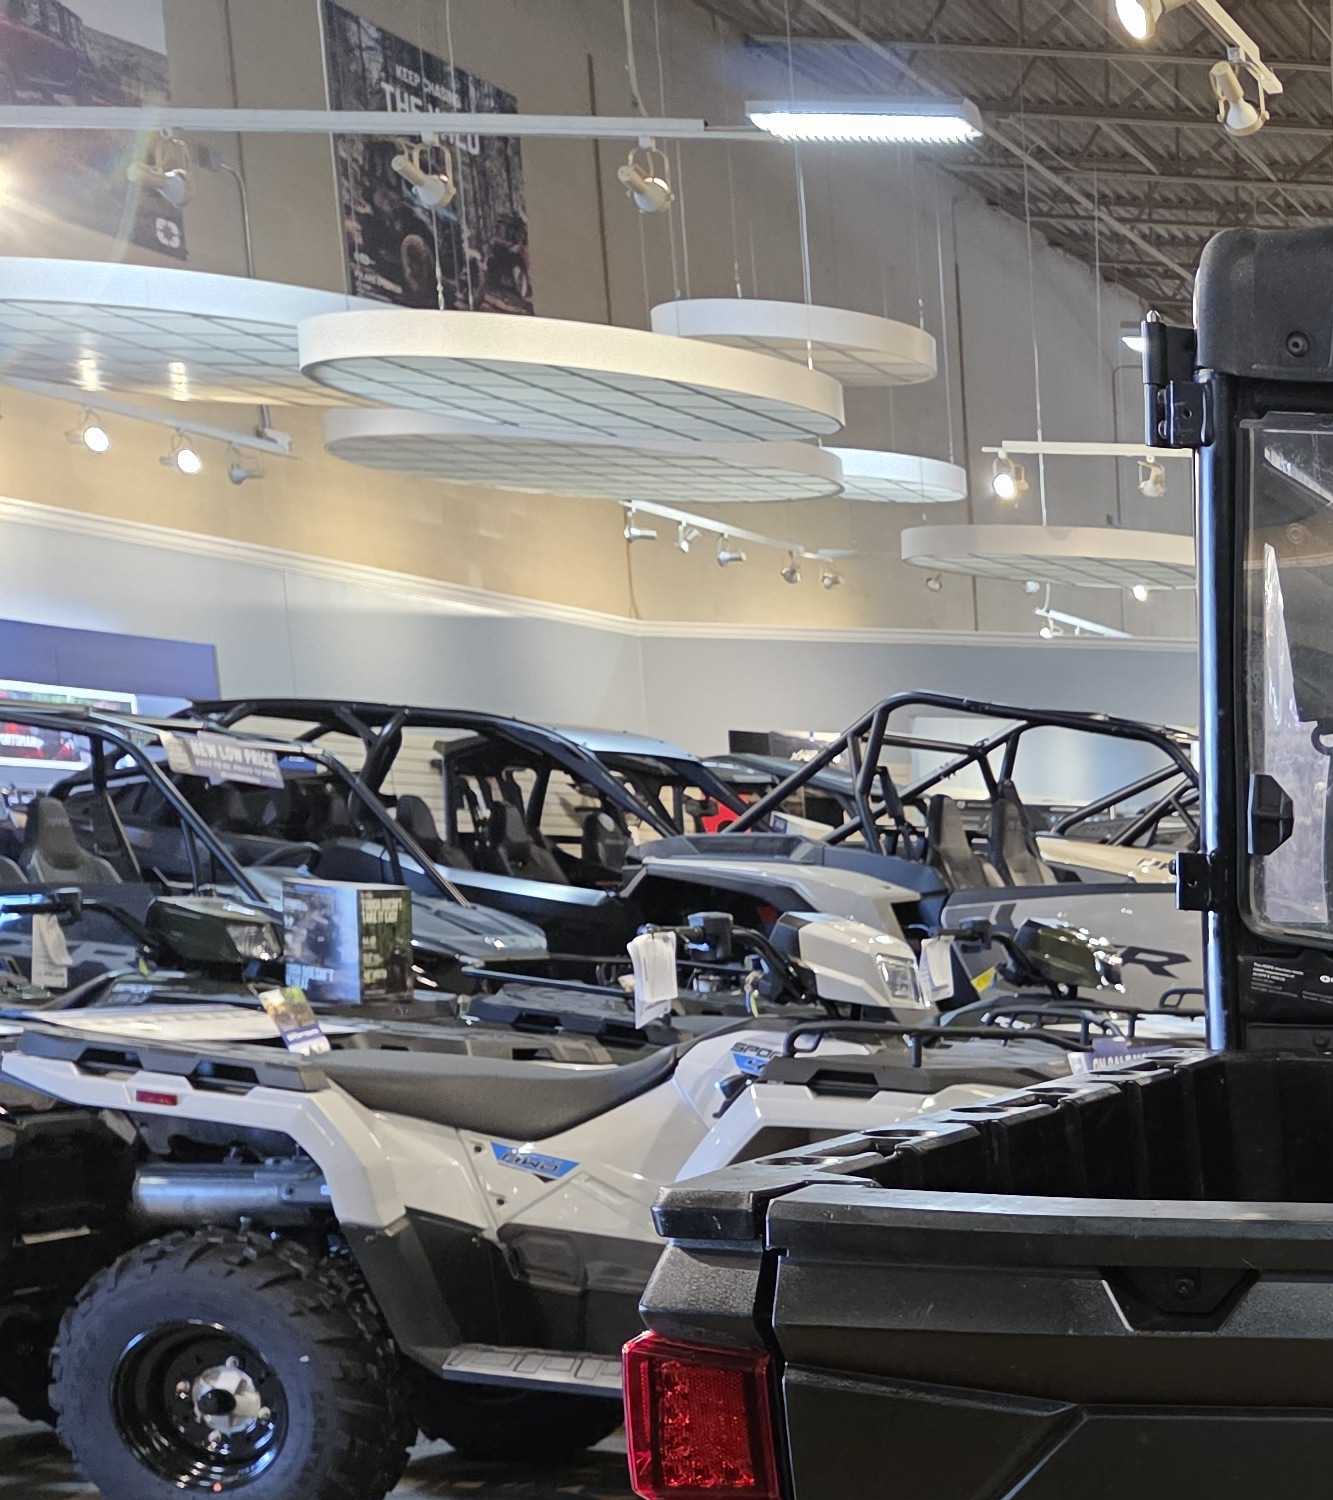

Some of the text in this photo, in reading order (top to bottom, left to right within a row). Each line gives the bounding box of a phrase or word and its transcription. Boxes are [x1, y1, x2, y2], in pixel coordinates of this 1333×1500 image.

[395, 63, 421, 88] KEEP
[191, 739, 276, 770] NEW LOW PRICE
